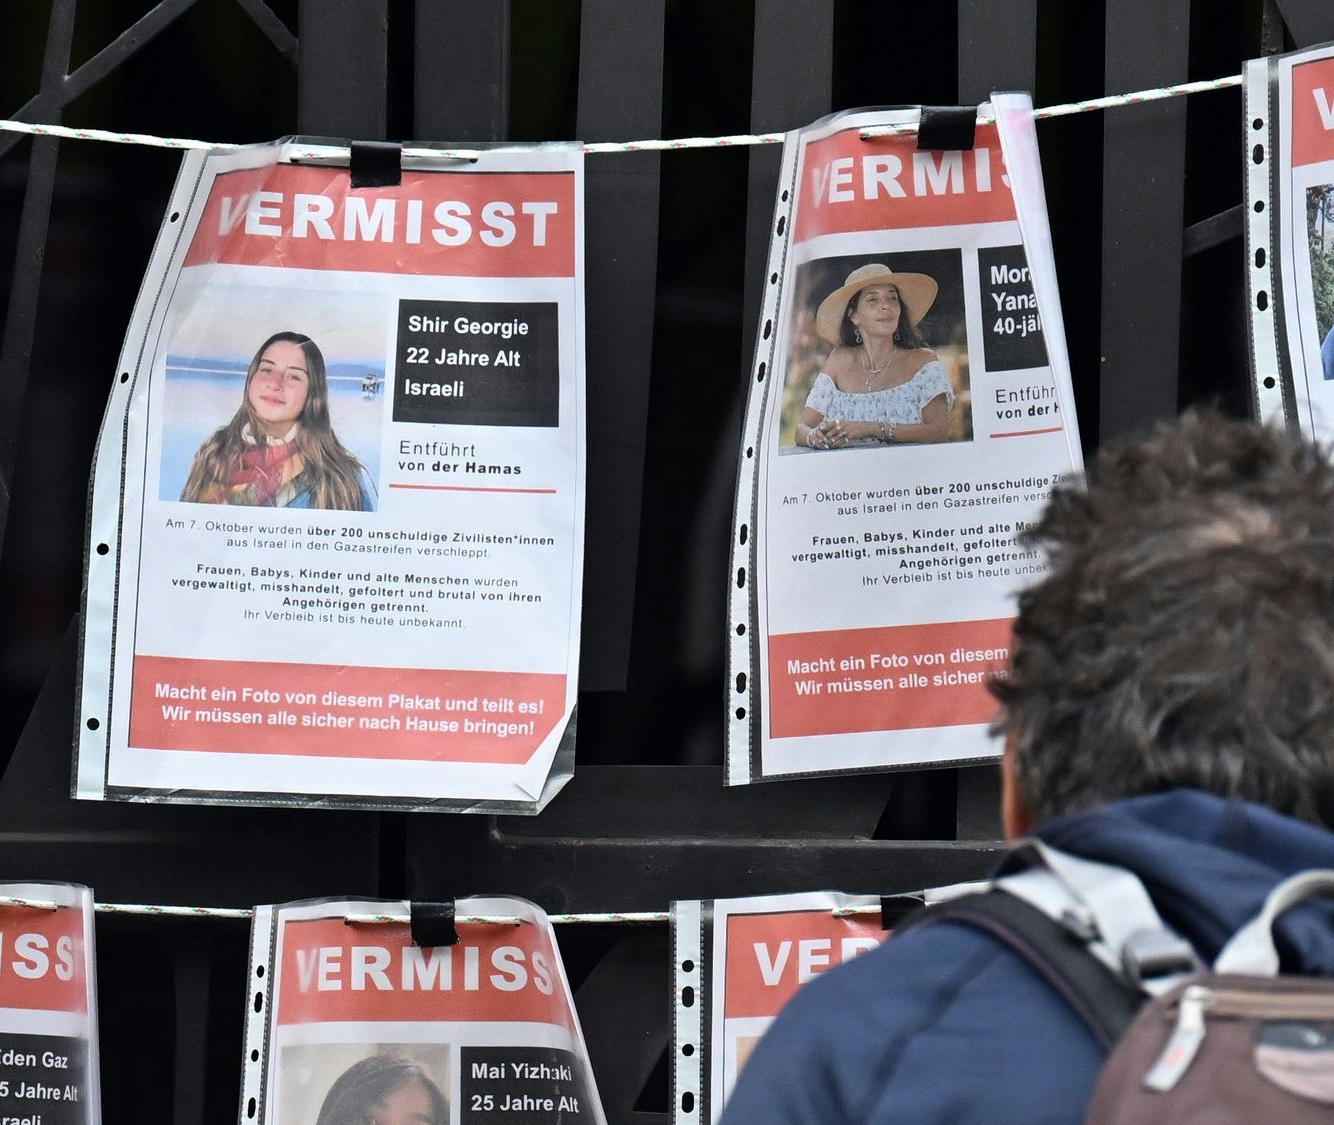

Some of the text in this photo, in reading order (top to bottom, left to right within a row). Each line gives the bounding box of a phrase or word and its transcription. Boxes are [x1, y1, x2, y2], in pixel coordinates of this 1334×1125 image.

[812, 147, 1011, 209] VERMI
[218, 190, 559, 247] VERMISST
[990, 264, 1033, 286] Mor
[407, 314, 529, 339] Shir Georgie
[405, 346, 521, 367] 22 Jahre Alt
[404, 378, 464, 398] Israeli
[996, 408, 1022, 420] von
[1028, 405, 1050, 417] der
[165, 517, 185, 529] Am
[190, 519, 201, 529] 7.
[204, 520, 254, 533] Oktober
[257, 525, 302, 535] wurden
[306, 525, 337, 537] über
[340, 526, 363, 538] 200
[367, 530, 448, 543] unschuldige
[471, 1062, 572, 1082] Mai Yizhaki
[13, 1081, 61, 1101] Jahre
[62, 1084, 78, 1102] Alt
[470, 1093, 580, 1114] 25 Jahre Alt
